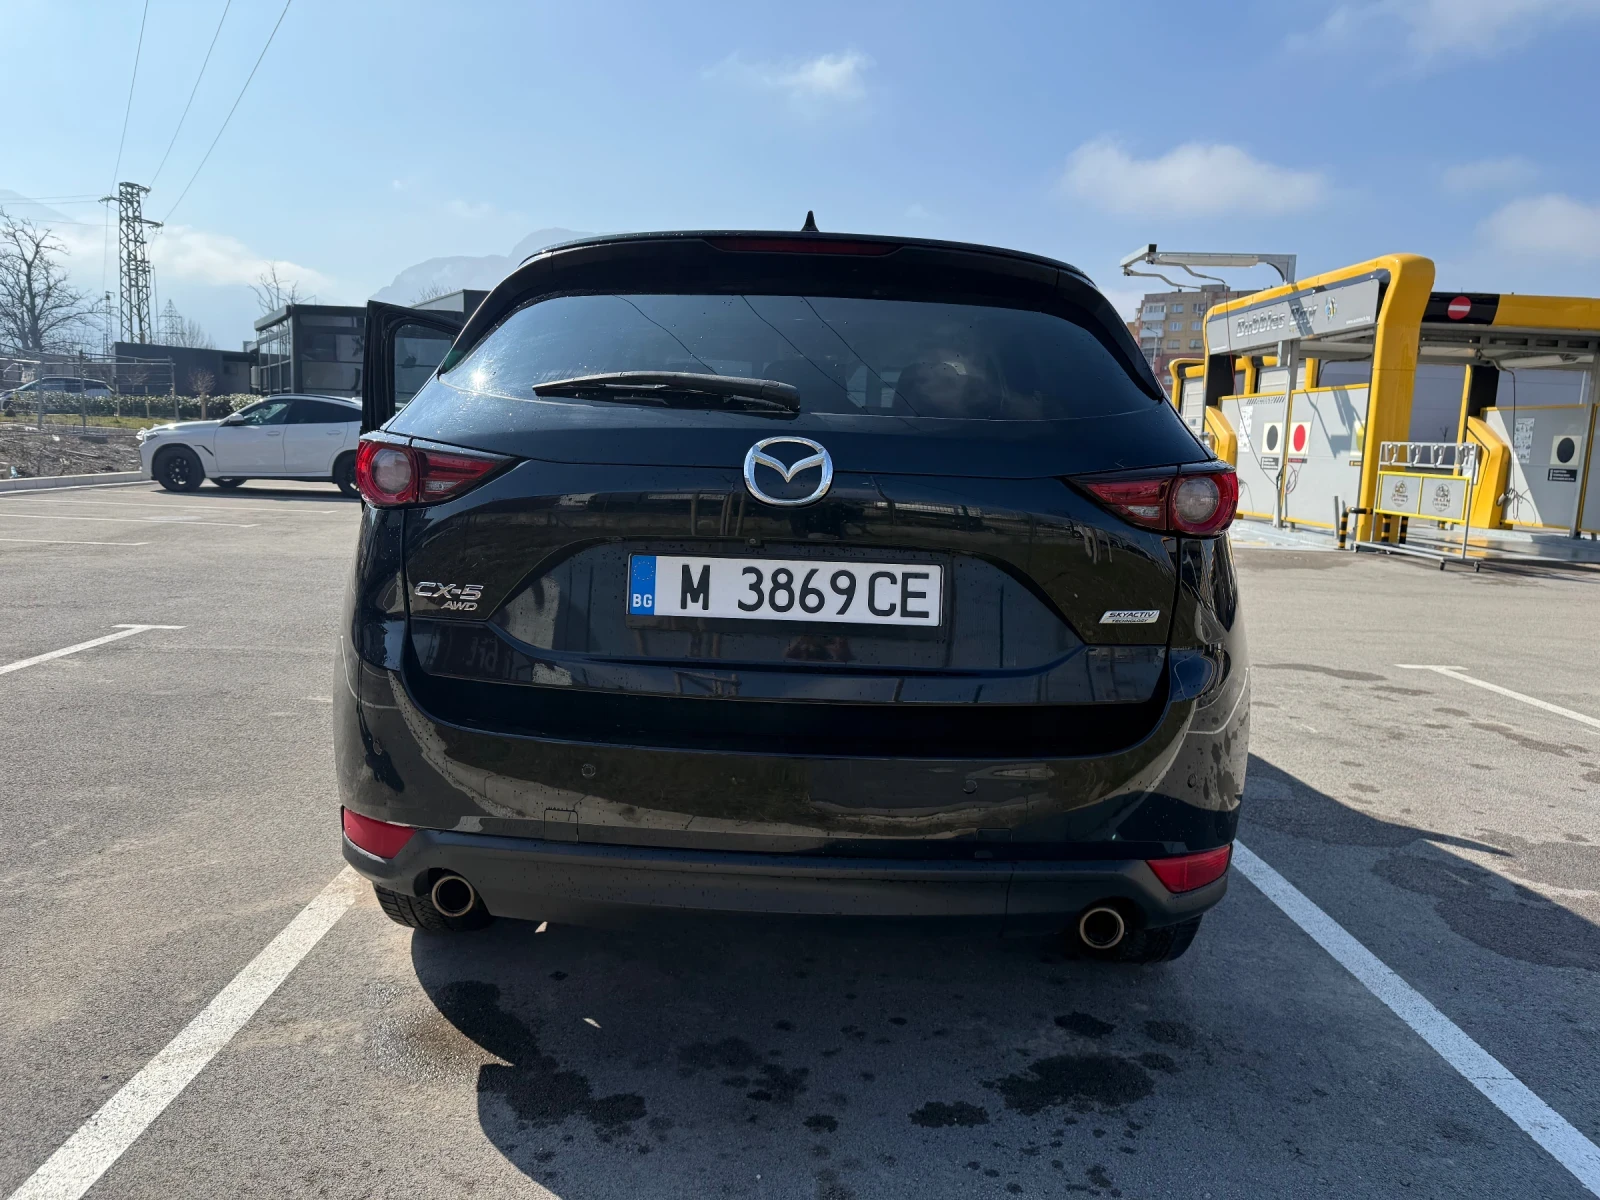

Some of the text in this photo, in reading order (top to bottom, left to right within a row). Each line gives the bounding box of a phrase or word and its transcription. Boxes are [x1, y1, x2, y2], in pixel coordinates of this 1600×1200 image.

[1236, 310, 1285, 337] Bubbles
[414, 581, 484, 600] CX-5
[632, 593, 652, 607] BG
[680, 564, 930, 618] M 3869 CE
[440, 600, 478, 611] AWD
